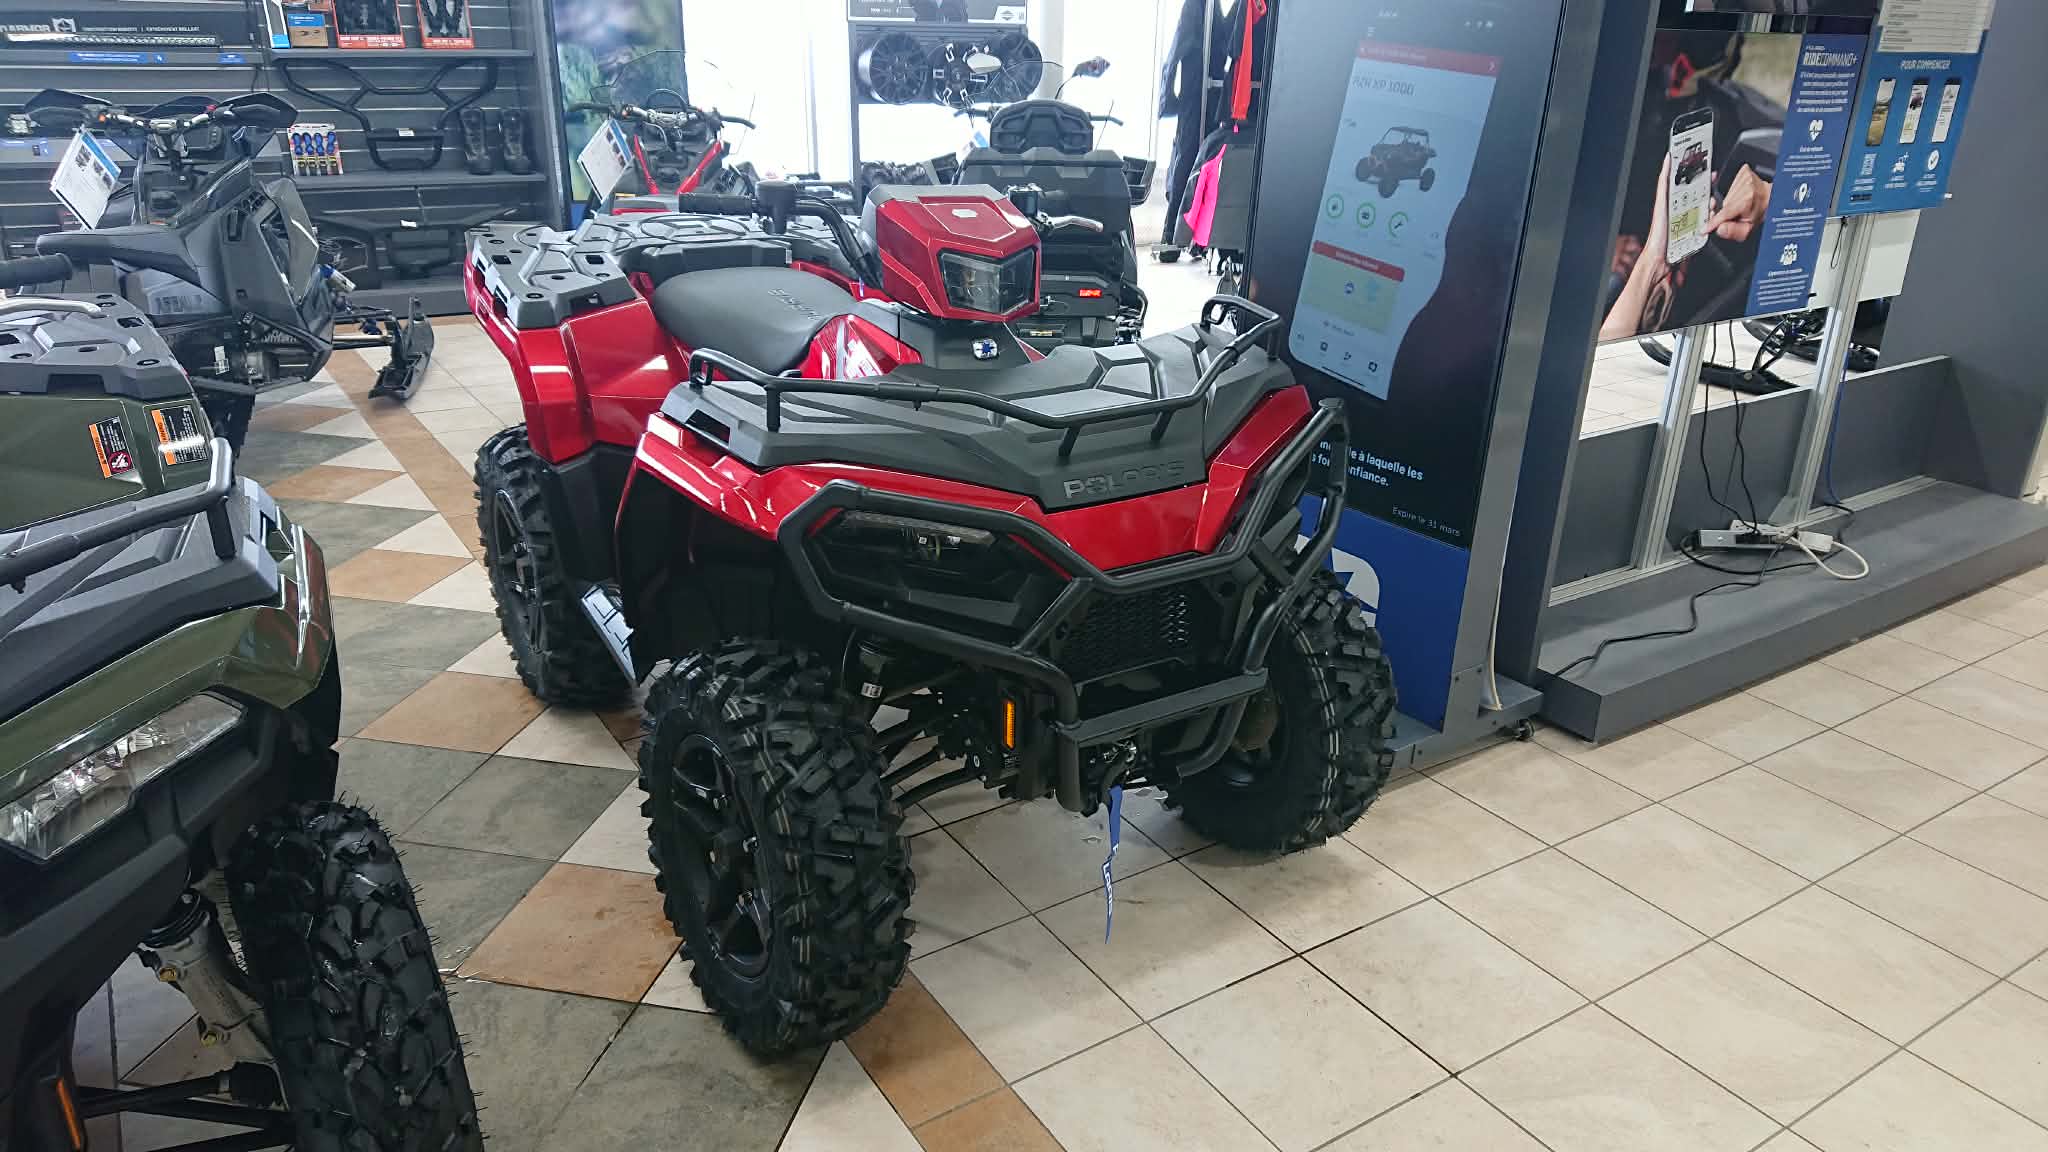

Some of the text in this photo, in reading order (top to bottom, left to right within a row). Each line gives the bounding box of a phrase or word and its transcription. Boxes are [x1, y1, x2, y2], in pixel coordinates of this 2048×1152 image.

[1803, 52, 1857, 66] RIDECOMMAND+
[1388, 80, 1415, 97] 1000
[1347, 465, 1389, 487] nfiance.
[1359, 450, 1365, 462] à
[1366, 452, 1406, 476] laquelle
[1407, 465, 1424, 481] les
[1063, 460, 1185, 499] POLARIS
[1392, 506, 1417, 520] Expire
[1427, 519, 1437, 529] 31
[1439, 525, 1460, 537] mars
